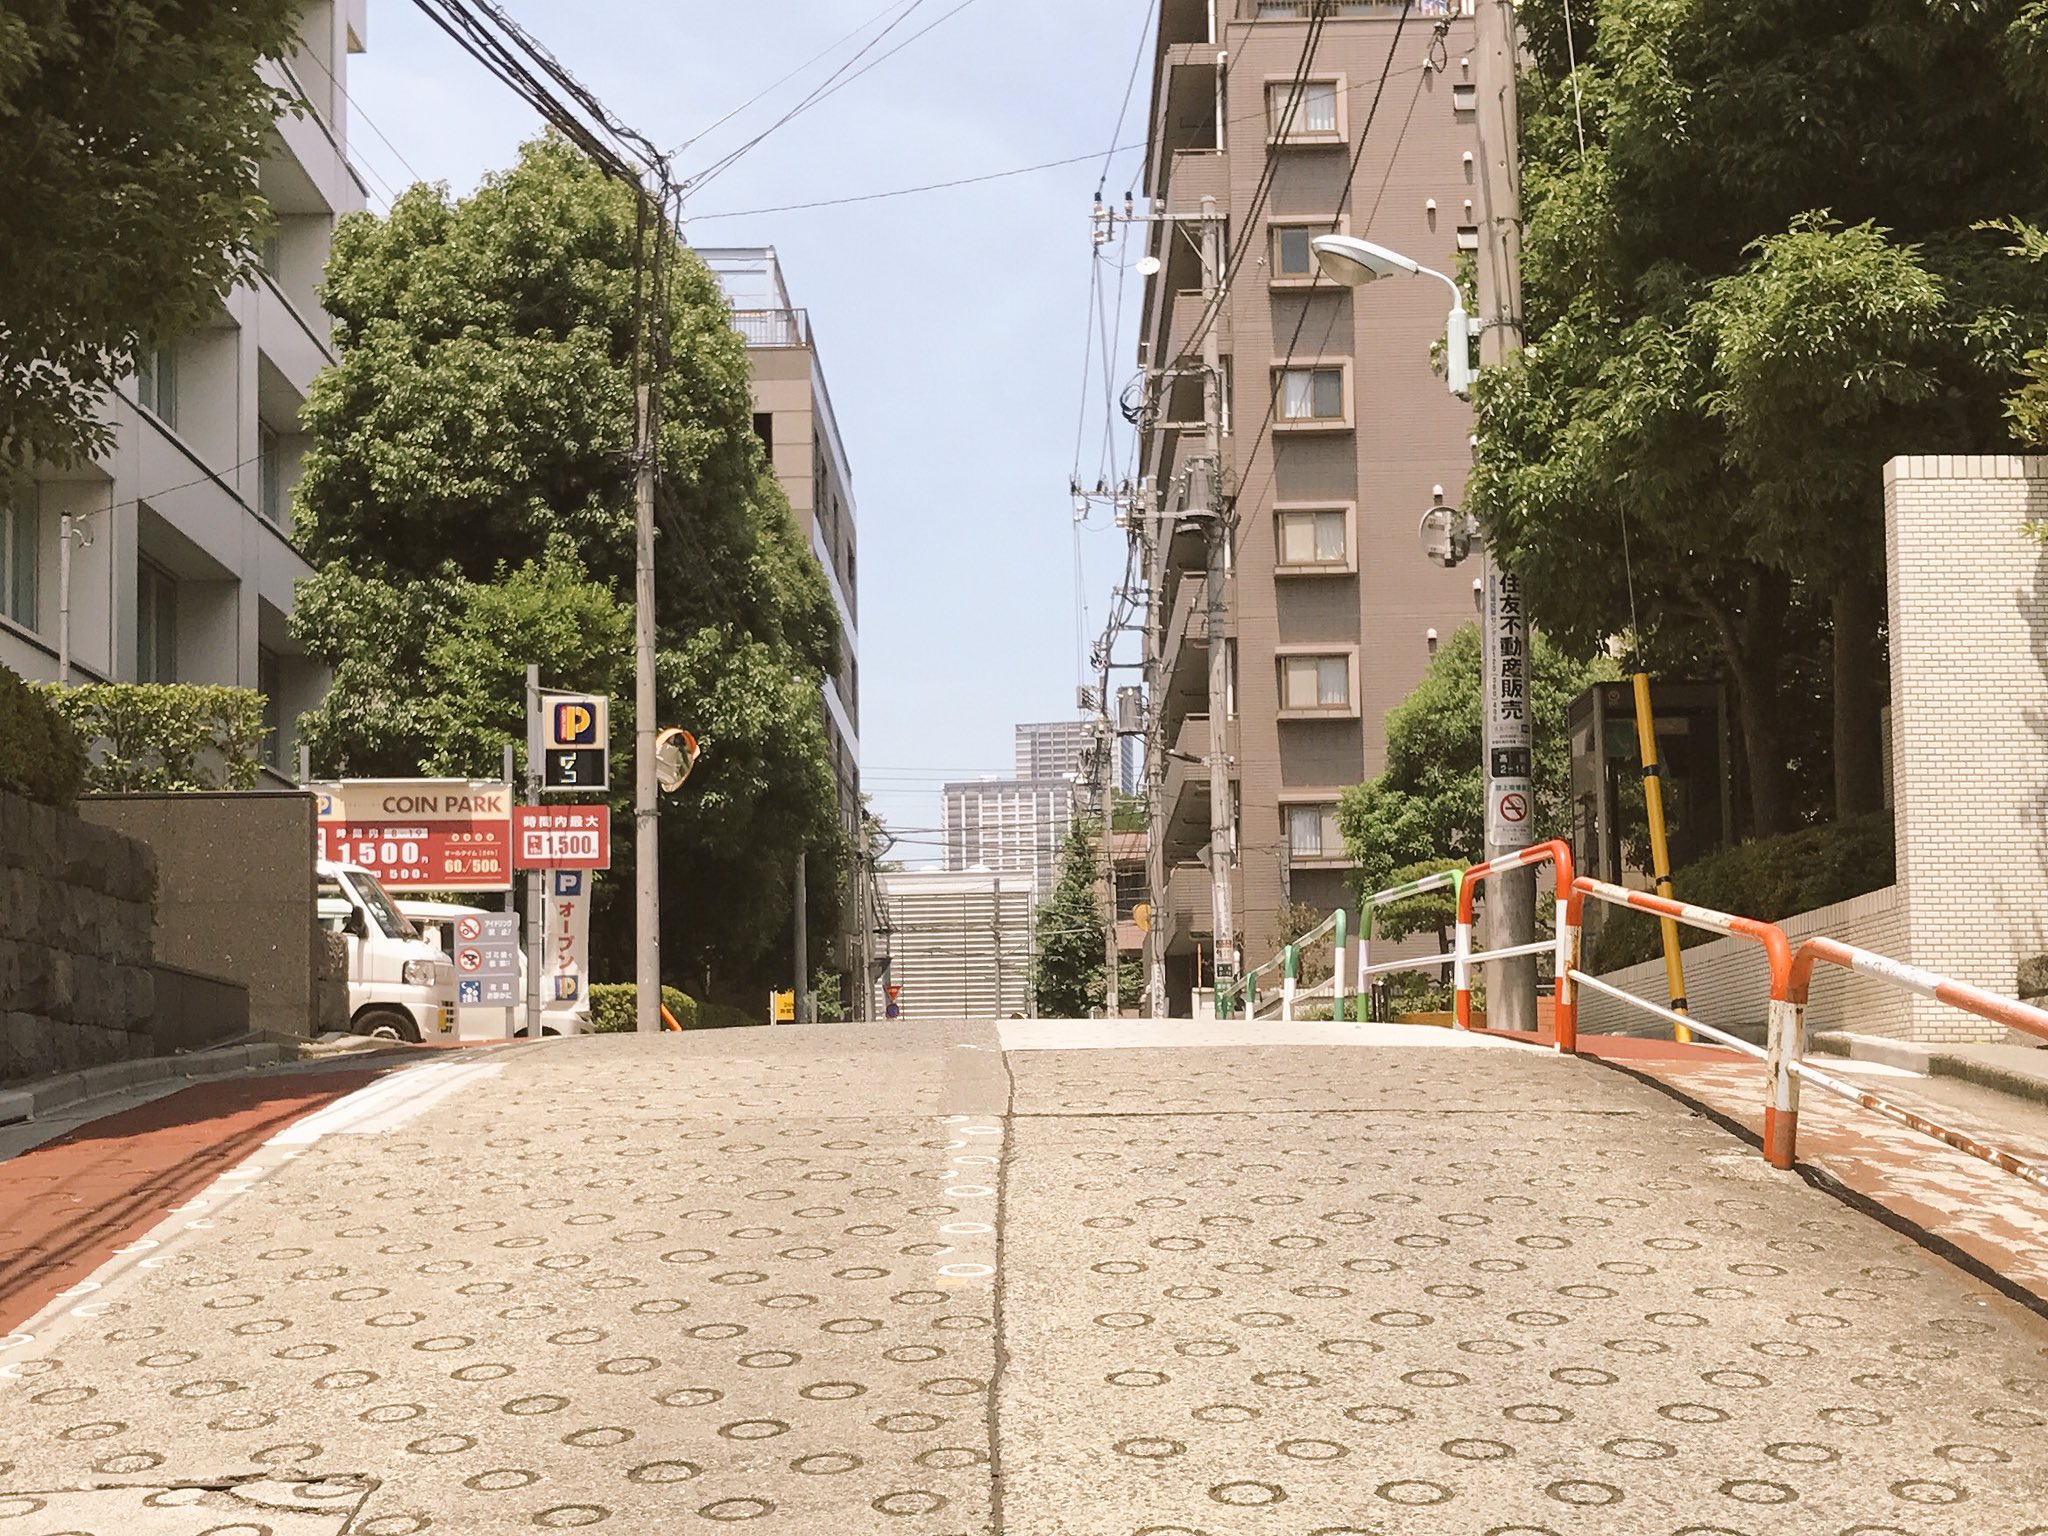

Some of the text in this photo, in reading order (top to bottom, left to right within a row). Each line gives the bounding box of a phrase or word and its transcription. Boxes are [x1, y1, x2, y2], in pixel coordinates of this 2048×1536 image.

[1500, 573, 1523, 721] 住友不動産販売
[566, 706, 591, 742] P
[383, 796, 502, 813] COIN PARK
[523, 815, 600, 829] 時間内最大
[560, 875, 577, 892] P
[558, 901, 575, 970] オープン
